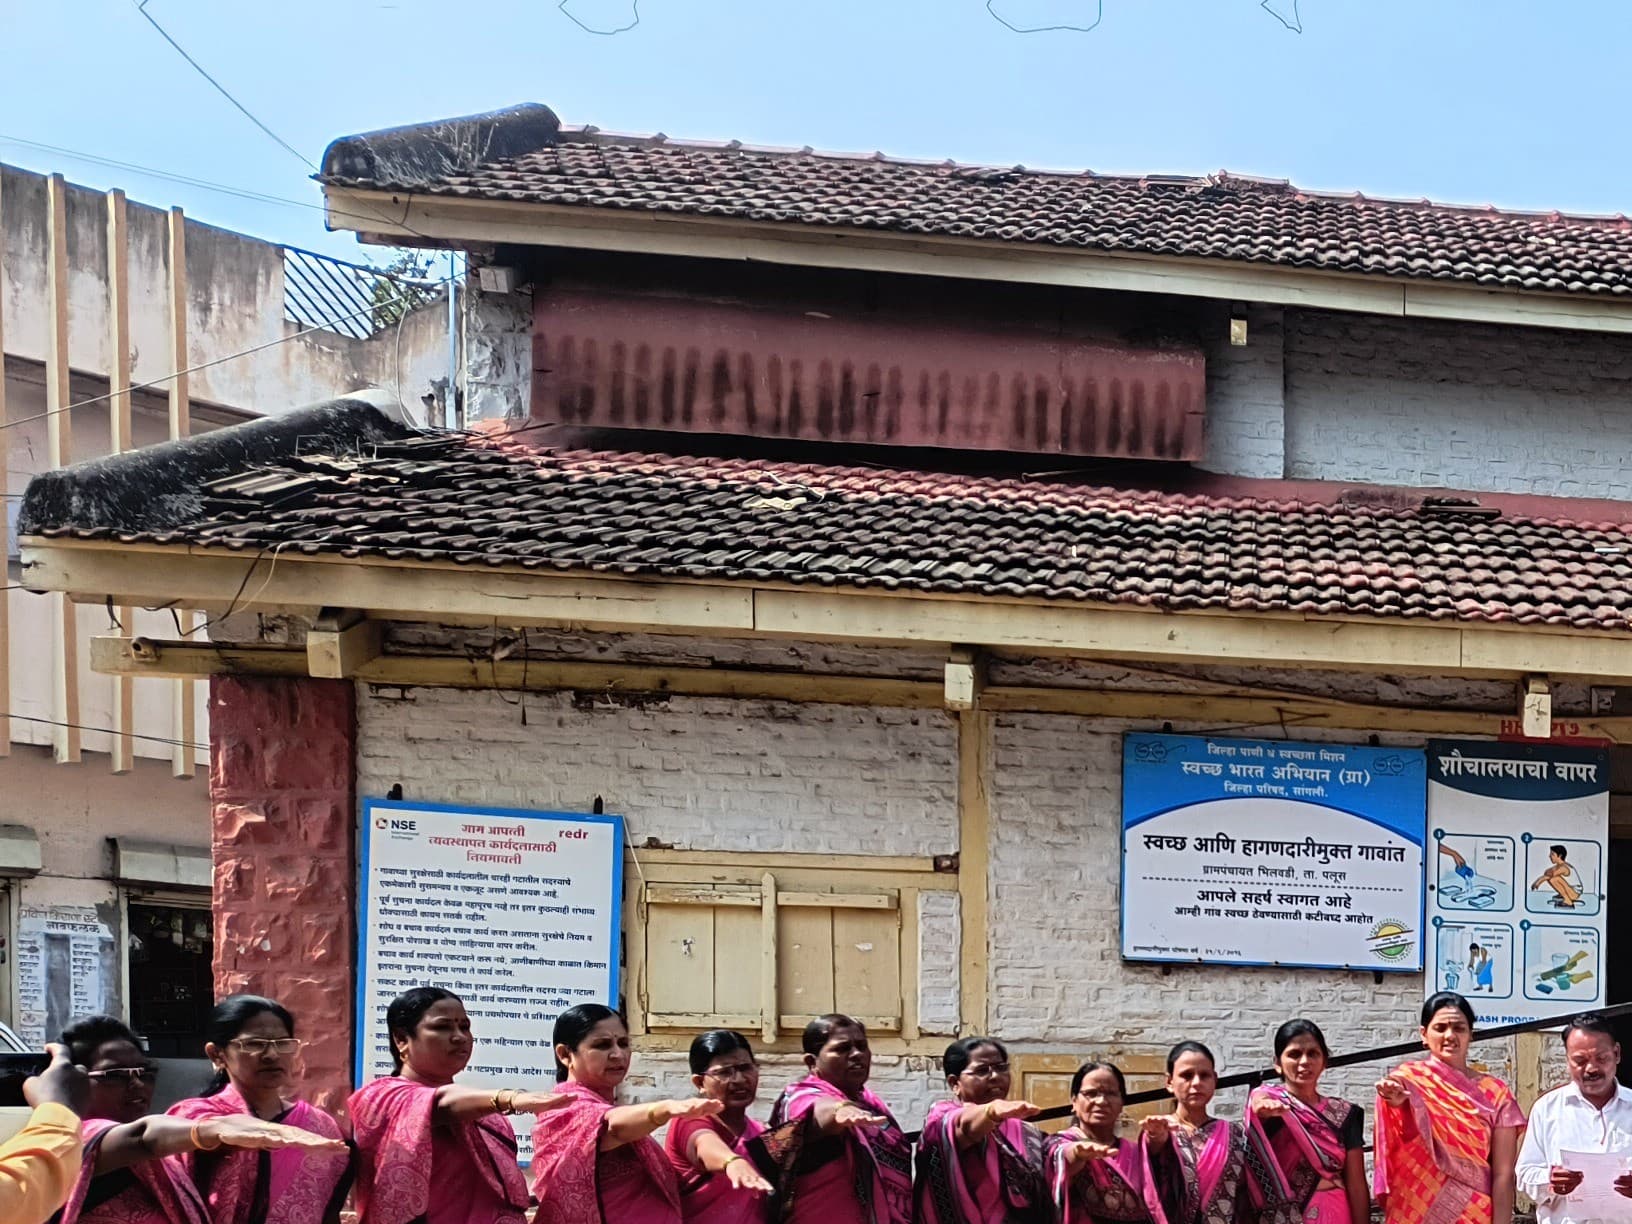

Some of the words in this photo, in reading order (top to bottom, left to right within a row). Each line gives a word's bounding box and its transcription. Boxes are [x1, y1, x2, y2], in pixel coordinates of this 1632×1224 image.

[1207, 742, 1236, 755] जिल्हा
[1280, 750, 1316, 761] स्वच्छता
[1320, 749, 1345, 762] मिशन
[1181, 760, 1223, 777] स्वच्छ
[1229, 763, 1265, 778] भारत
[1272, 762, 1331, 782] अभियान
[1338, 768, 1372, 787] (ग्रा)
[1438, 748, 1548, 780] शौचालयाचा
[1554, 762, 1598, 783] वापर
[1224, 780, 1252, 793] जिल्हा
[1256, 783, 1289, 797] परिषद,
[391, 820, 416, 830] NSE
[558, 828, 589, 839] redr
[467, 850, 522, 865] नियमावली
[1143, 834, 1187, 852] स्वच्छ
[1193, 831, 1236, 854] आणि
[1241, 836, 1353, 864] हागणदारीमुक्त
[1357, 840, 1406, 864] गावांत
[1203, 863, 1254, 877] ग्रामपंचायत
[1257, 865, 1298, 880] भिलवडी,
[1303, 870, 1318, 880] ता.
[1322, 870, 1347, 884] पलूस
[1197, 887, 1237, 903] आपले
[1241, 888, 1273, 905] सहर्ष
[1277, 893, 1320, 907] स्वागत
[1325, 892, 1352, 909] आहे
[1174, 905, 1201, 917] आम्ही
[1224, 908, 1249, 918] स्वच्छ
[1252, 907, 1302, 921] ठेवण्यासाठी
[1344, 911, 1374, 924] आहोत
